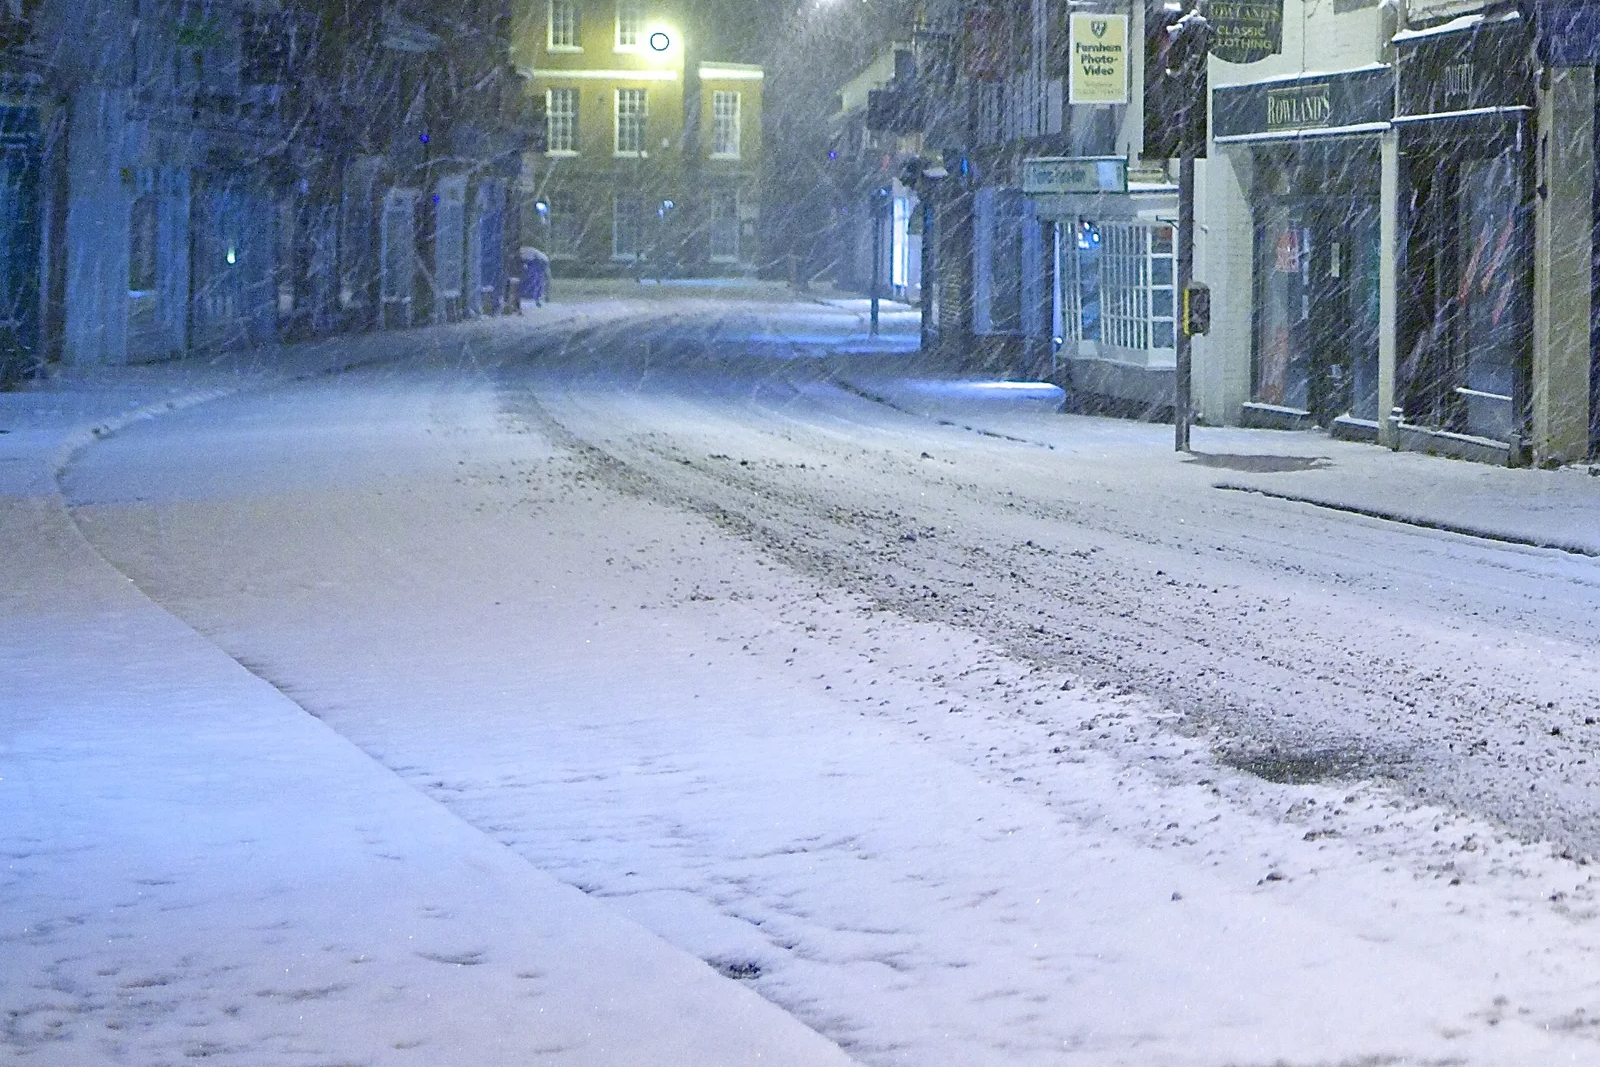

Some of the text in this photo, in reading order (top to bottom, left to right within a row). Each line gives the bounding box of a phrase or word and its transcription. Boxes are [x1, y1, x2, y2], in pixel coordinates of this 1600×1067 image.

[1217, 24, 1266, 37] CLASSIC
[1076, 42, 1122, 53] Farnham
[1081, 53, 1118, 64] Photo-
[1083, 65, 1114, 76] Video
[1267, 90, 1331, 124] ROWLAND'S
